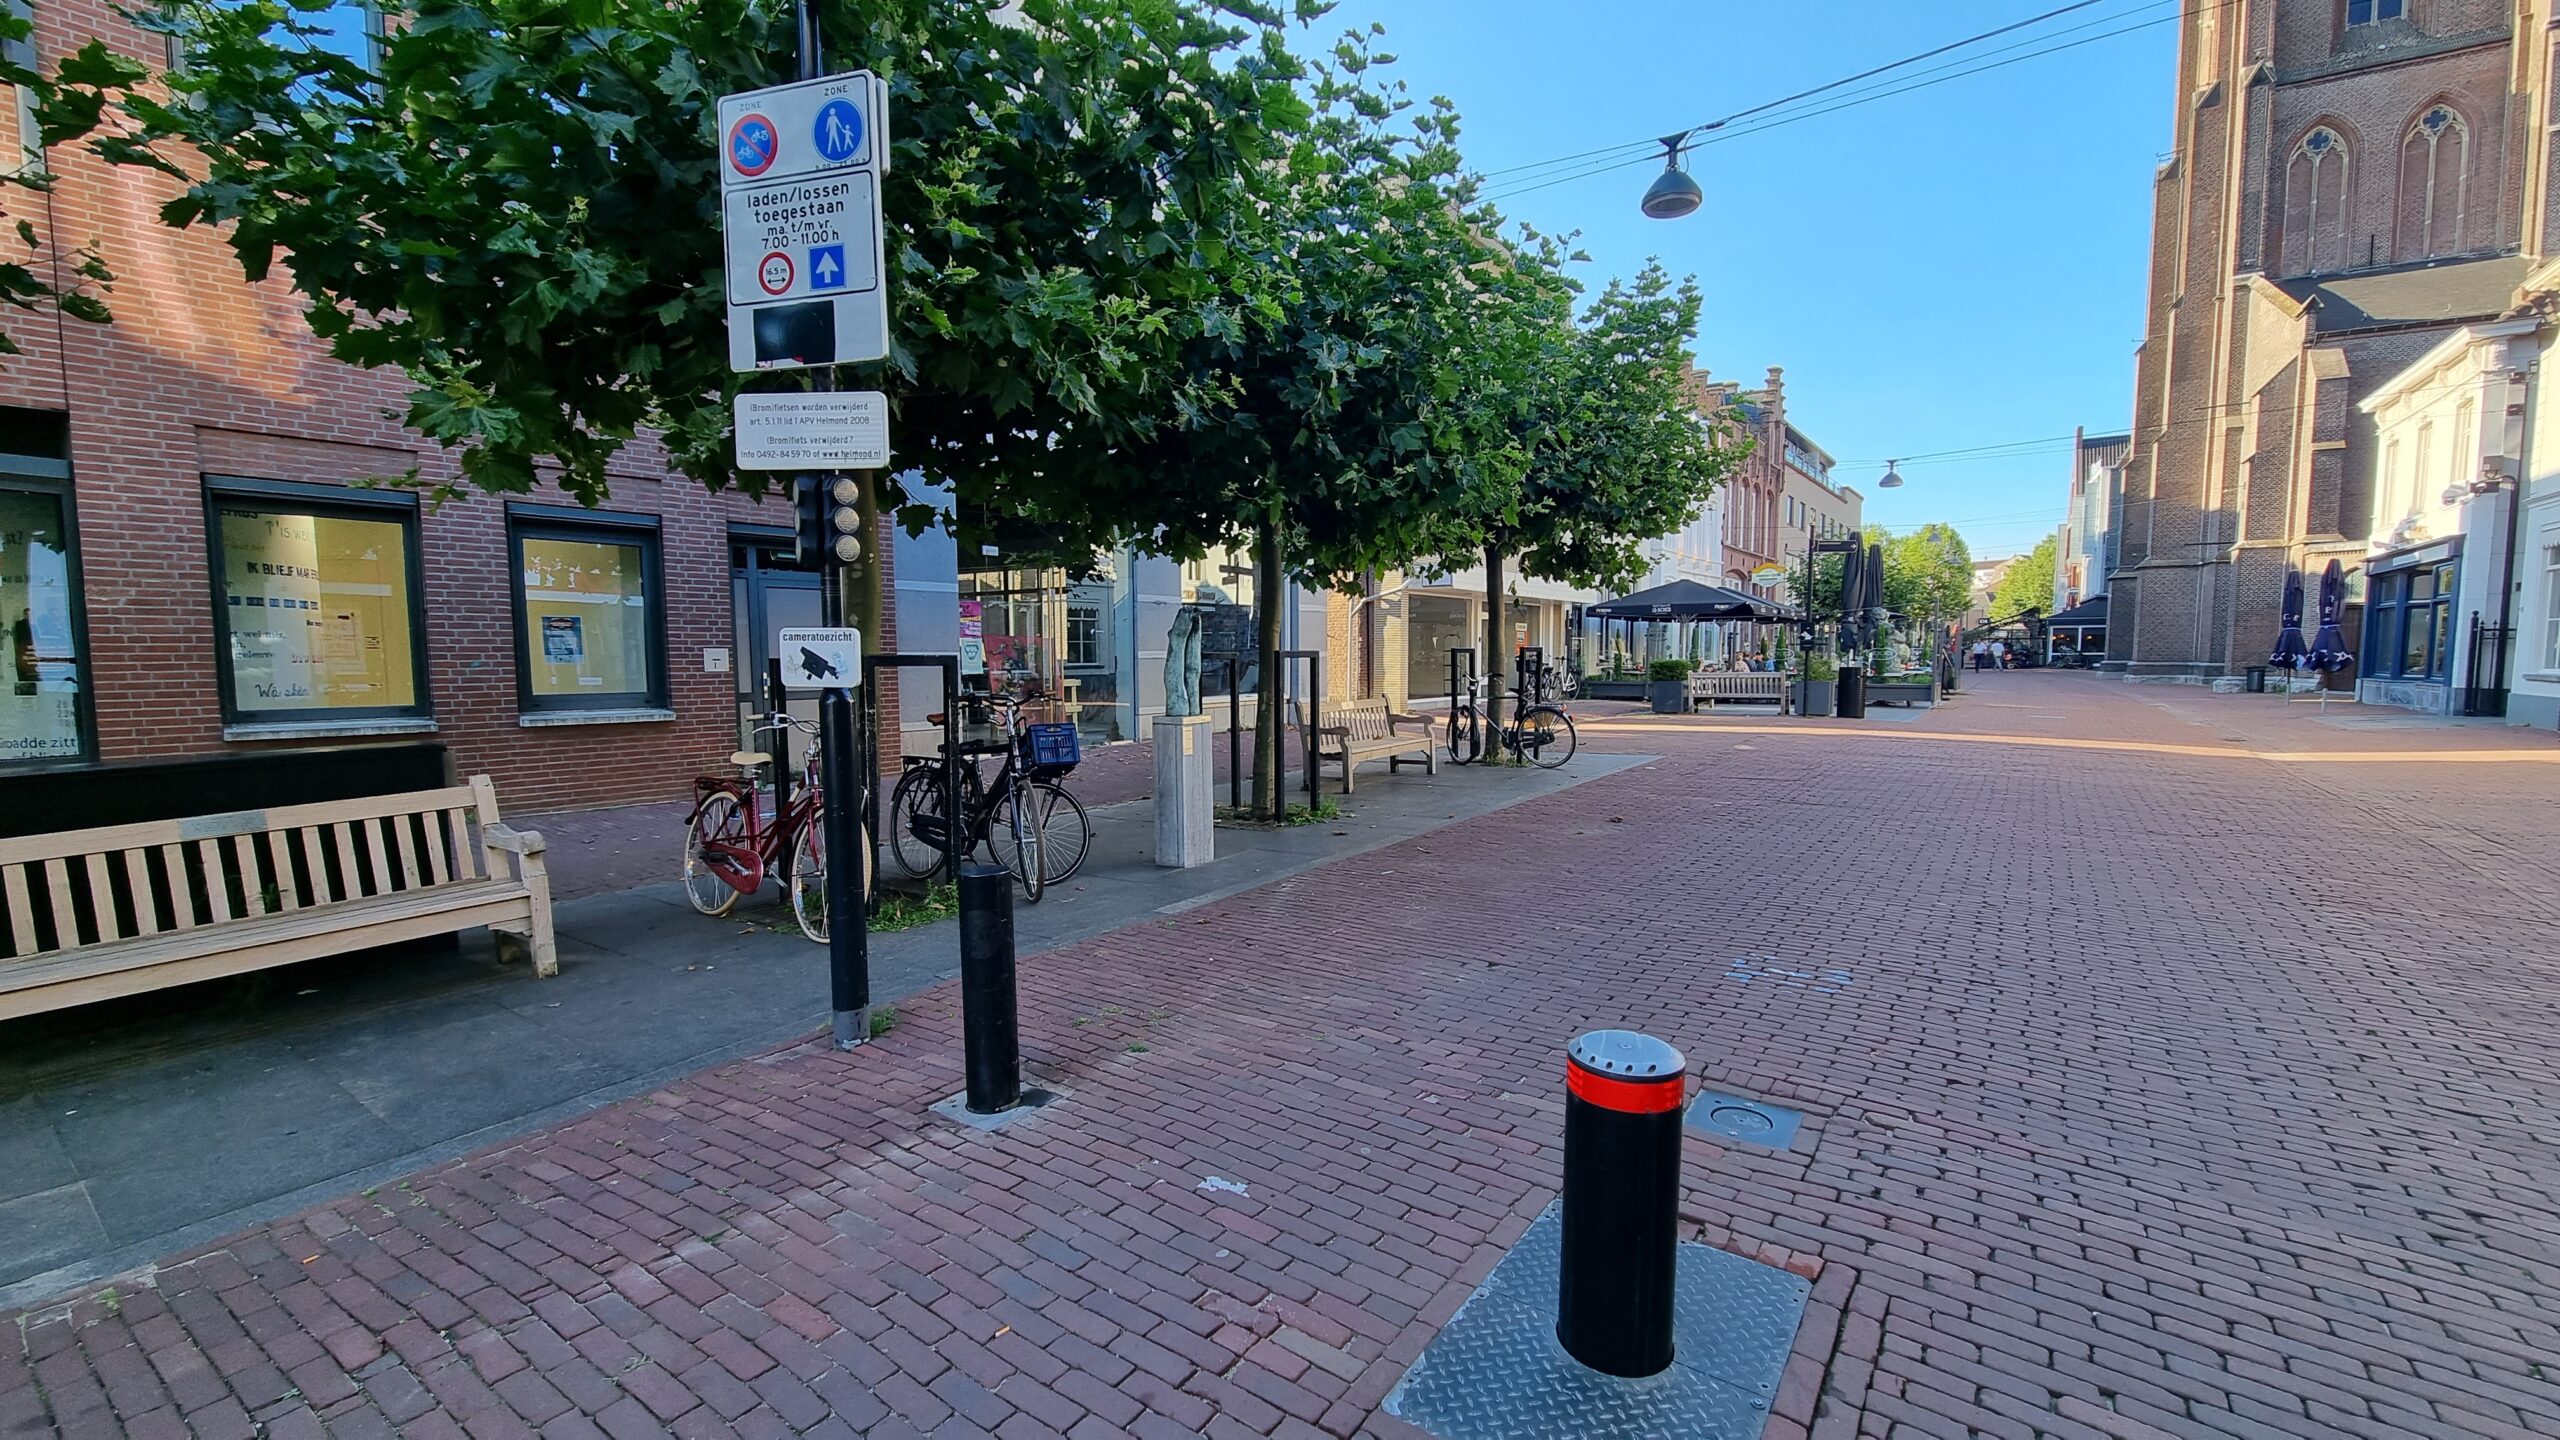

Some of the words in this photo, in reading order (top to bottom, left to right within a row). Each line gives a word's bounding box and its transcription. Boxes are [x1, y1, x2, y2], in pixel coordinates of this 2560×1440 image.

[824, 85, 849, 97] ZONE
[739, 101, 762, 112] ZONE
[748, 183, 849, 208] laden/lossen
[754, 201, 844, 224] toegestaan
[767, 225, 788, 237] ma.
[791, 221, 814, 233] t/m
[818, 220, 833, 230] vr.
[762, 236, 789, 250] 7.00
[801, 232, 829, 245] 11.00
[832, 230, 839, 241] h
[750, 403, 800, 413] (Brom)fietsen
[801, 403, 828, 412] worden
[829, 402, 869, 413] verwijderd
[749, 417, 762, 426] art.
[784, 416, 793, 425] lid
[799, 416, 815, 425] APV
[816, 416, 848, 425] Helmond
[850, 415, 870, 425] 2008
[766, 435, 808, 446] (Brom)fiets
[740, 450, 755, 459] Info
[782, 631, 853, 642] cameratoezicht
